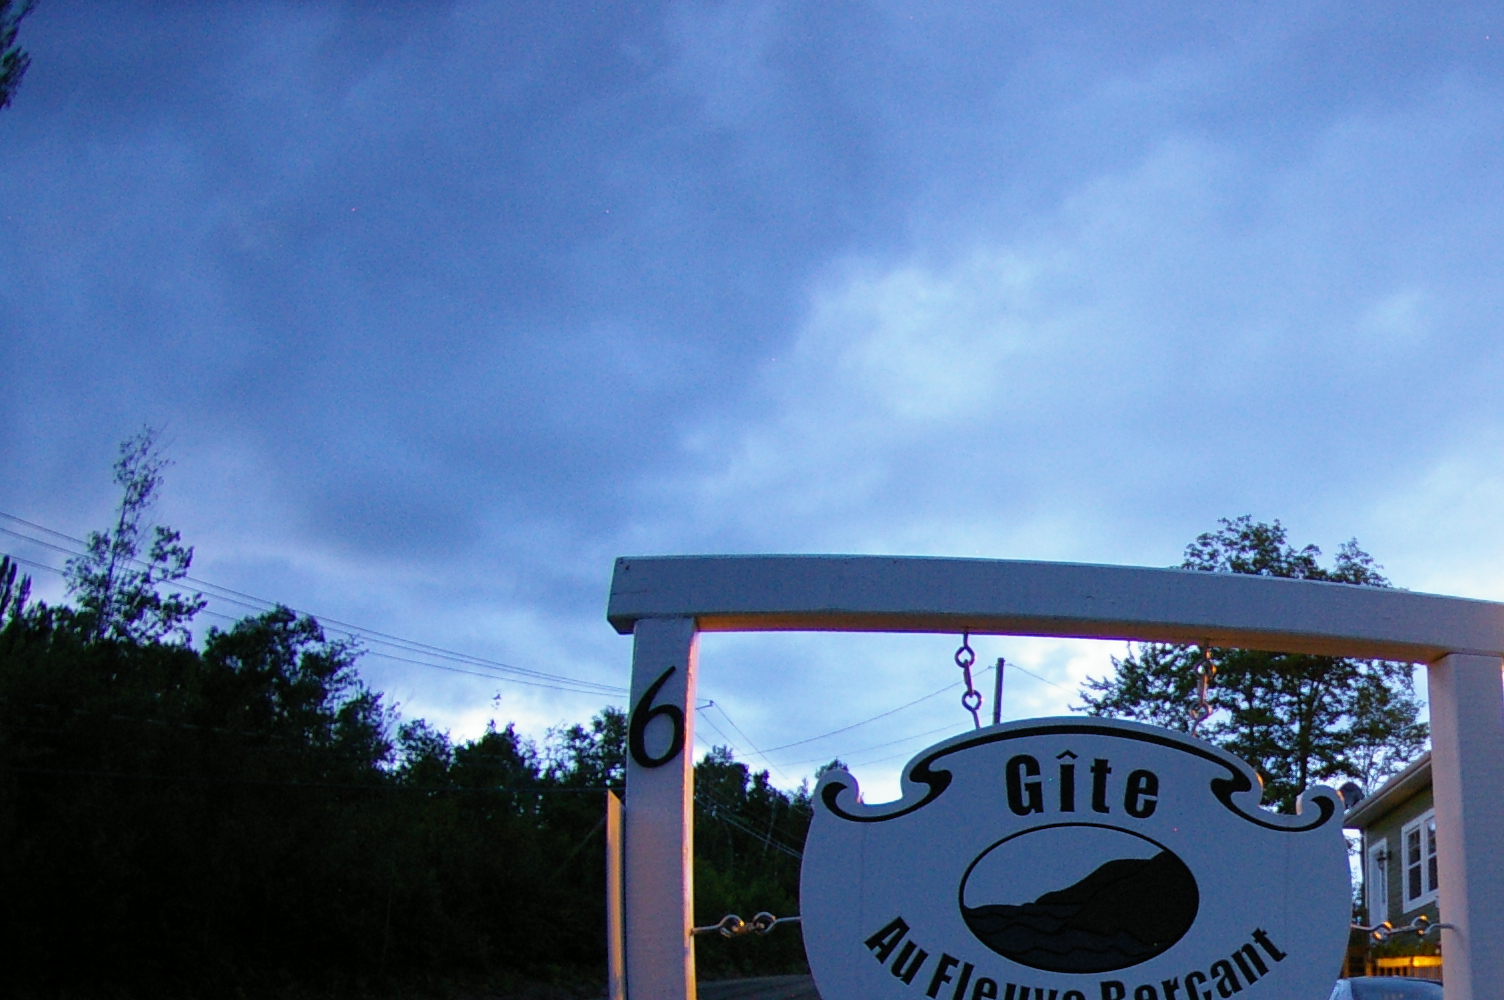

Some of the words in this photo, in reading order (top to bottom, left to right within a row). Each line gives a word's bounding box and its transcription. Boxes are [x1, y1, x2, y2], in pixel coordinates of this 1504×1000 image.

[629, 666, 685, 768] 6
[1006, 750, 1159, 818] Gîte
[863, 916, 926, 985] Au
